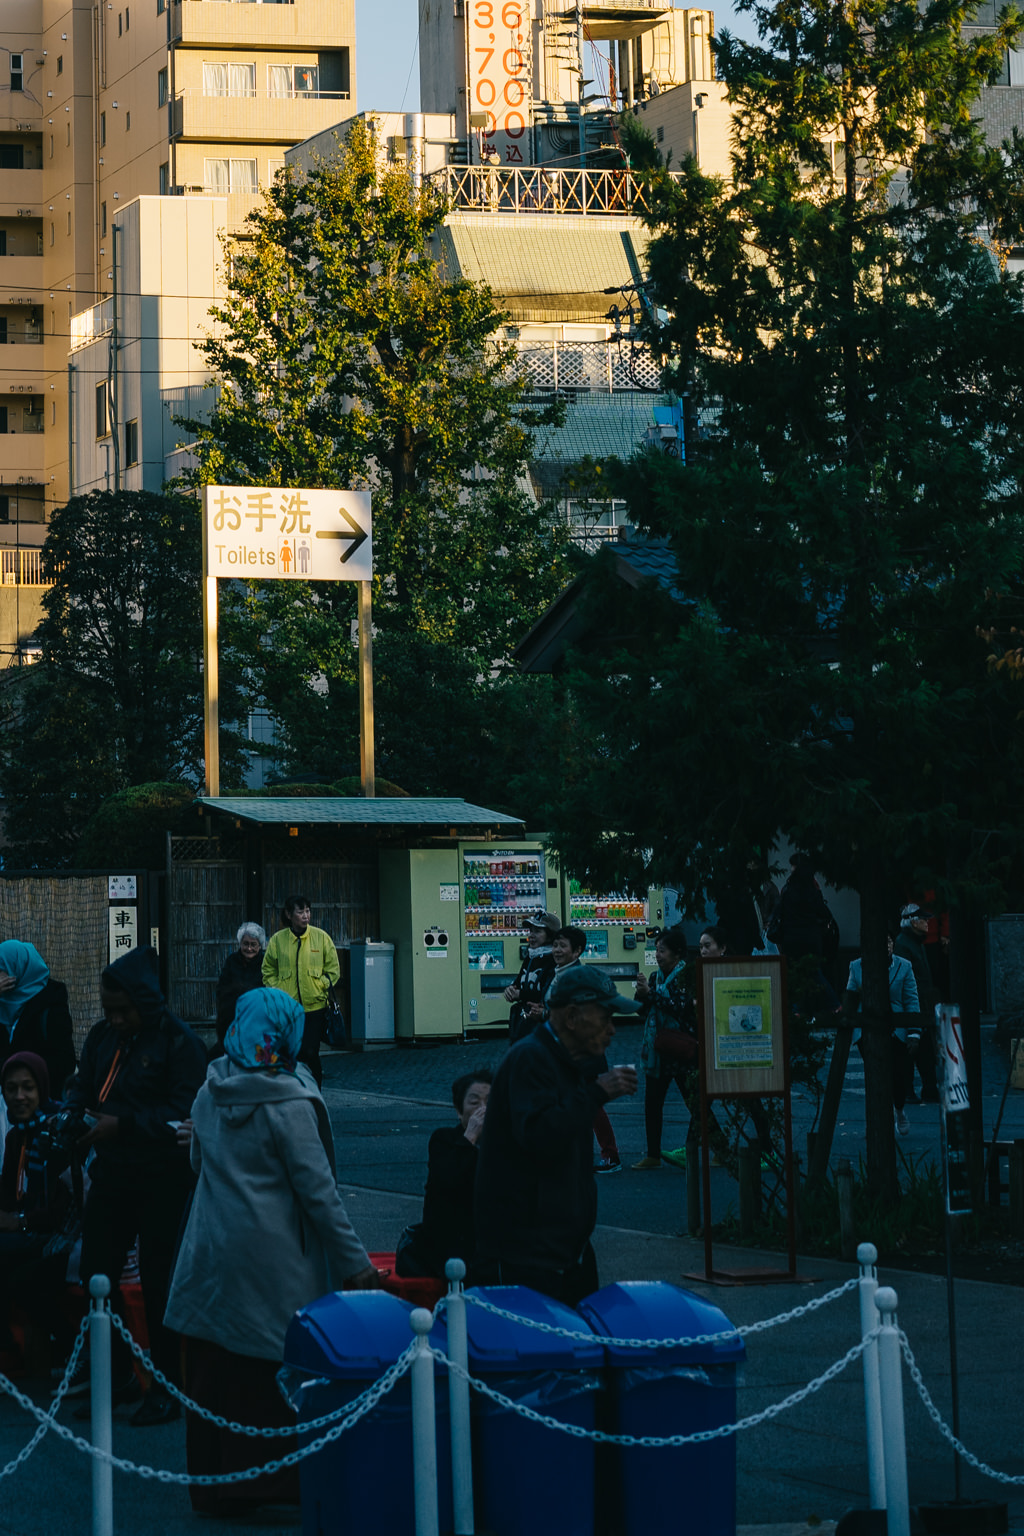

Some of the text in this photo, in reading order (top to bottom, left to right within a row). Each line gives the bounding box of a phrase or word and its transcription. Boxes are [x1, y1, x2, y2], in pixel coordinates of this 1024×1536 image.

[213, 490, 311, 534] お手洗
[215, 545, 276, 565] Toilets
[113, 911, 133, 948] 車両
